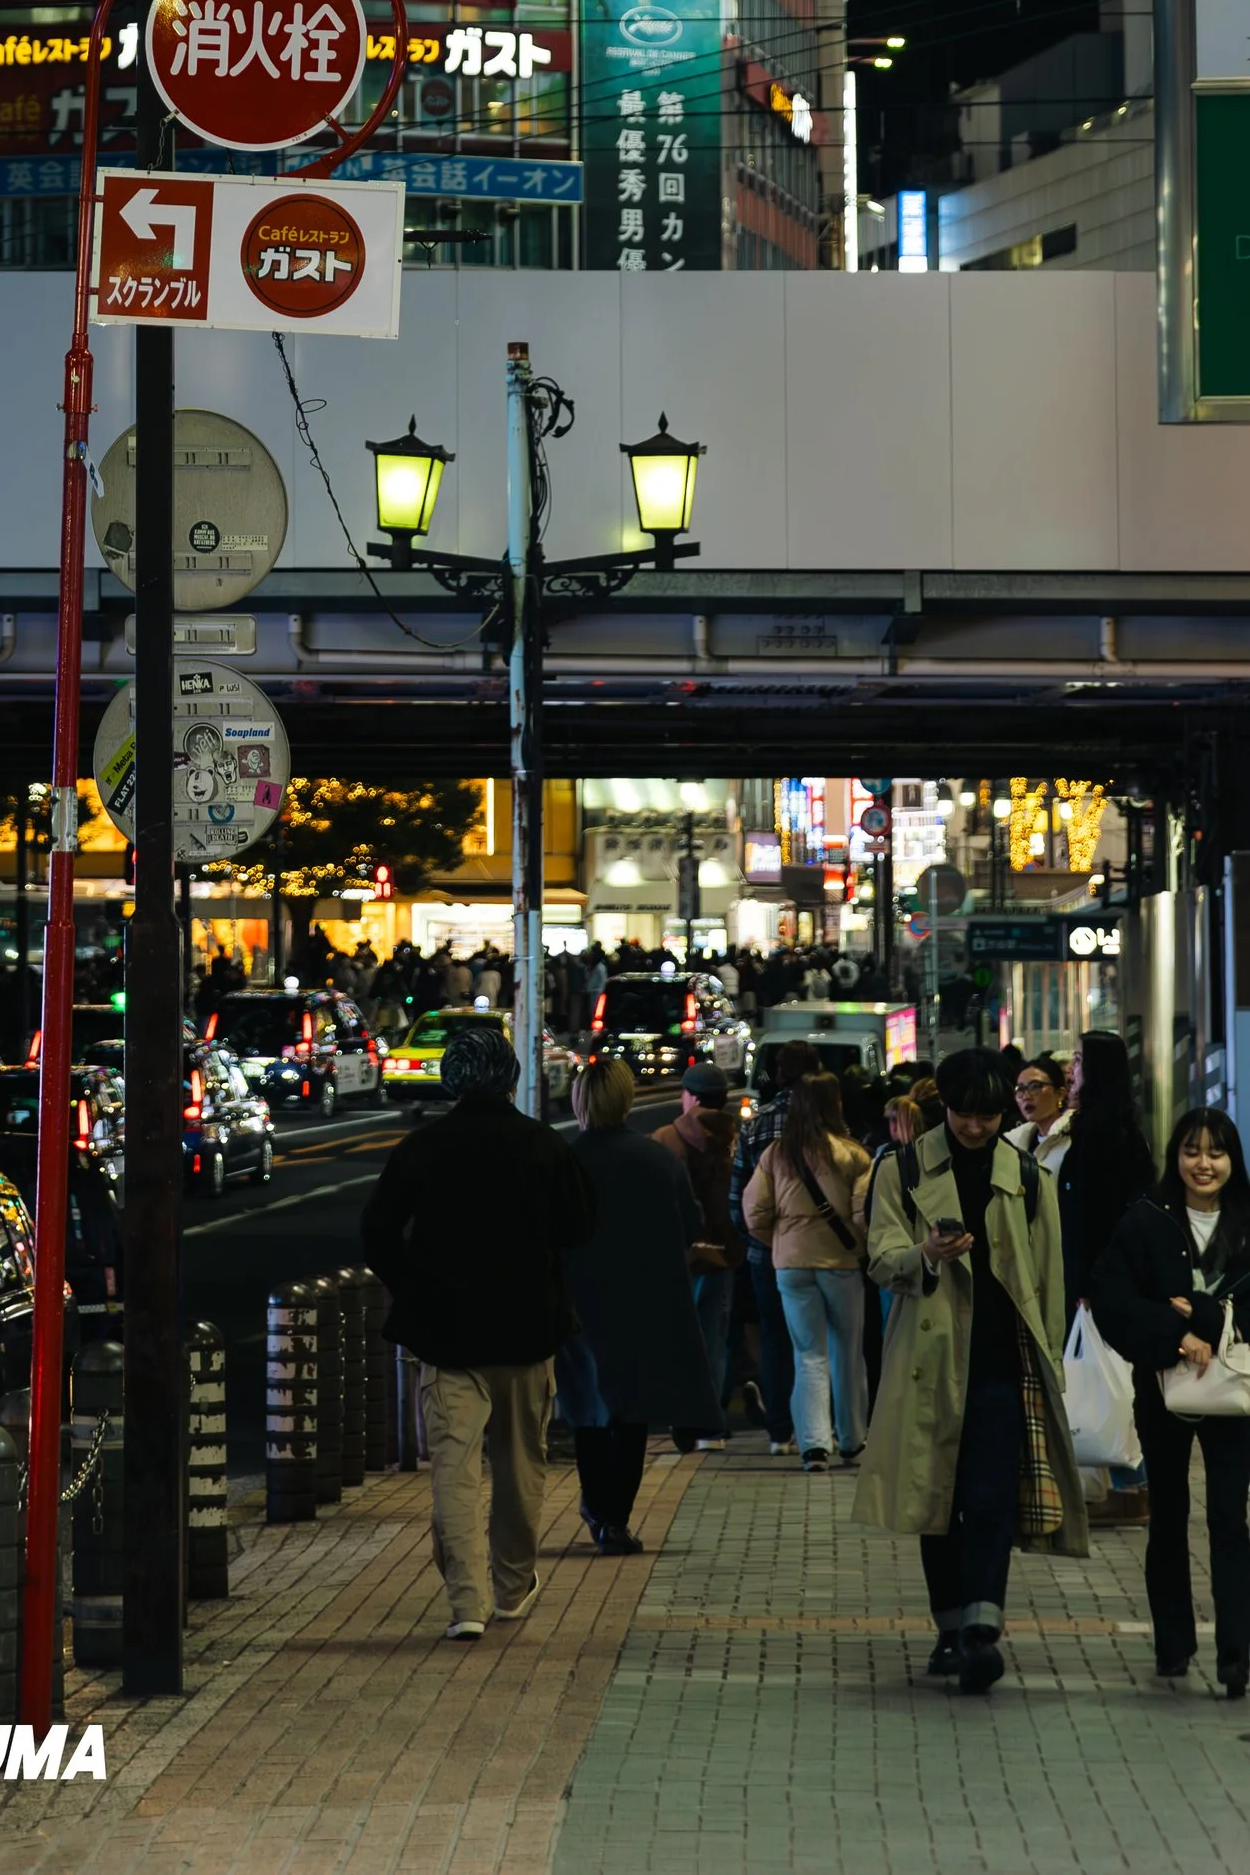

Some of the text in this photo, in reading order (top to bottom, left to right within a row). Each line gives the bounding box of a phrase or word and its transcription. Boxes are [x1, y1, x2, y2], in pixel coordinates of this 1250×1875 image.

[170, 0, 346, 82] 消火栓
[445, 27, 552, 79] ガスト
[258, 246, 352, 283] ガスト
[106, 275, 201, 309] スクランブル
[225, 727, 271, 738] Soapland
